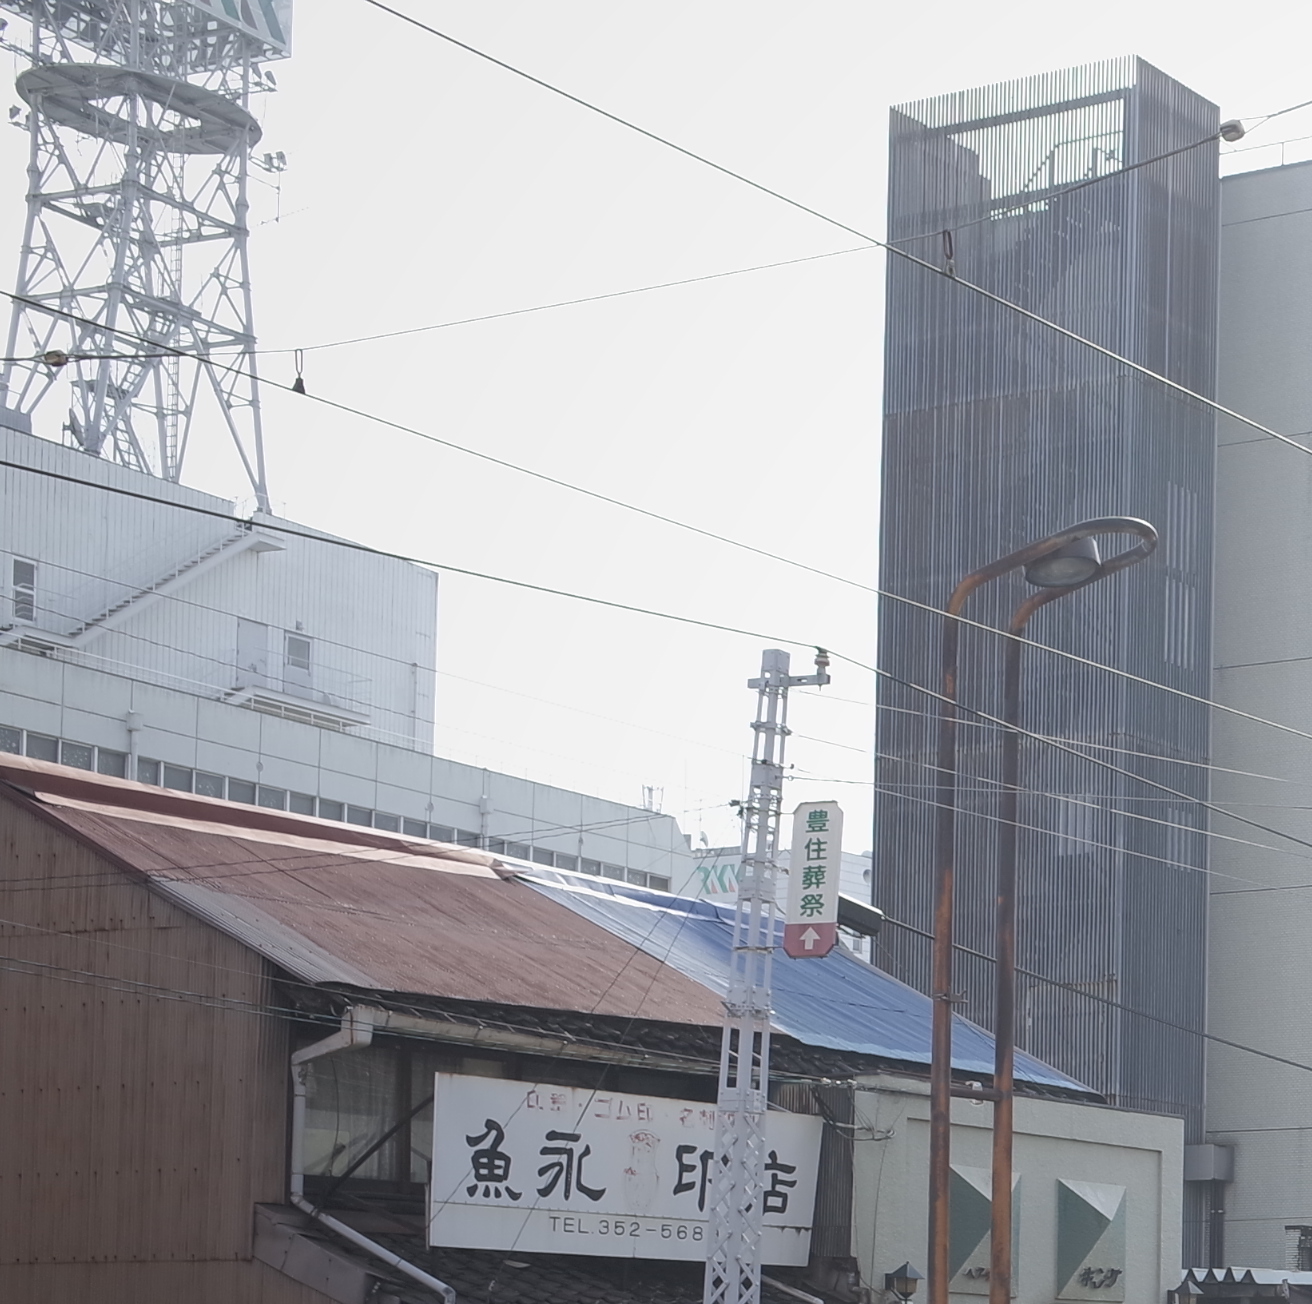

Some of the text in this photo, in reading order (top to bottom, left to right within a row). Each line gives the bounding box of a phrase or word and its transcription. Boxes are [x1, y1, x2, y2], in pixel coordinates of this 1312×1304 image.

[801, 809, 830, 918] 豊住葬祭
[465, 1118, 606, 1202] 魚永
[549, 1216, 720, 1243] TEL.352-568
[1079, 1266, 1122, 1289] キング
